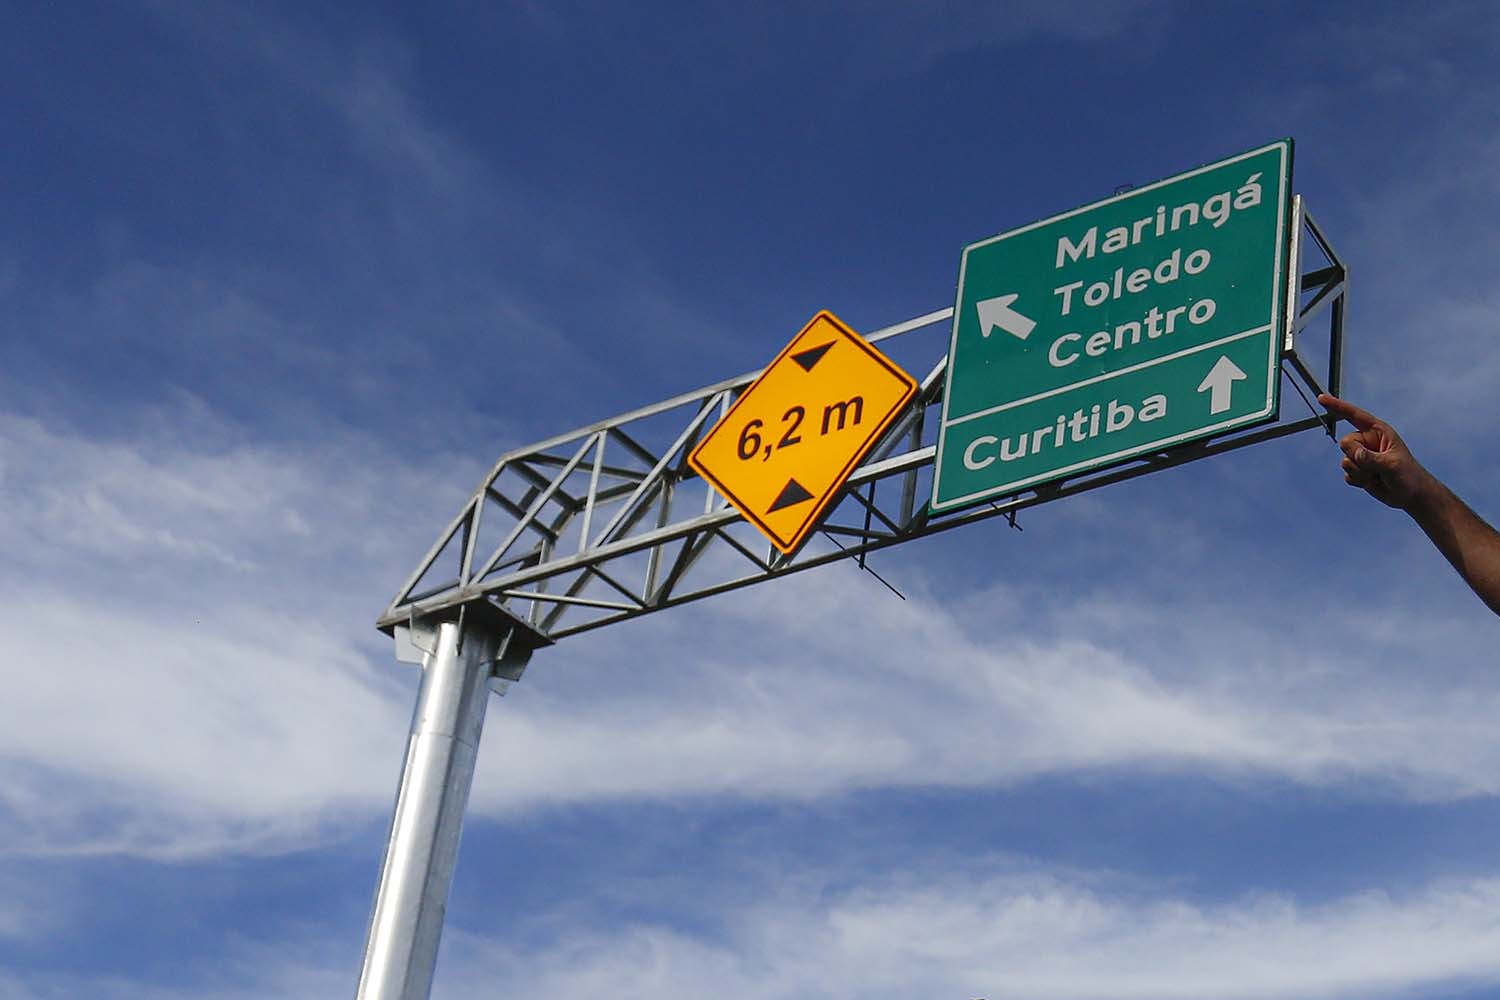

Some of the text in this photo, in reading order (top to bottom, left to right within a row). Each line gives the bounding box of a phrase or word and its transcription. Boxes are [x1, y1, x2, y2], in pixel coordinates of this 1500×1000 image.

[1055, 173, 1262, 268] Maringá
[1053, 249, 1211, 316] Toledo
[1048, 299, 1216, 367] Centro
[737, 396, 864, 462] 6,2 m
[963, 393, 1167, 470] Curitiba
